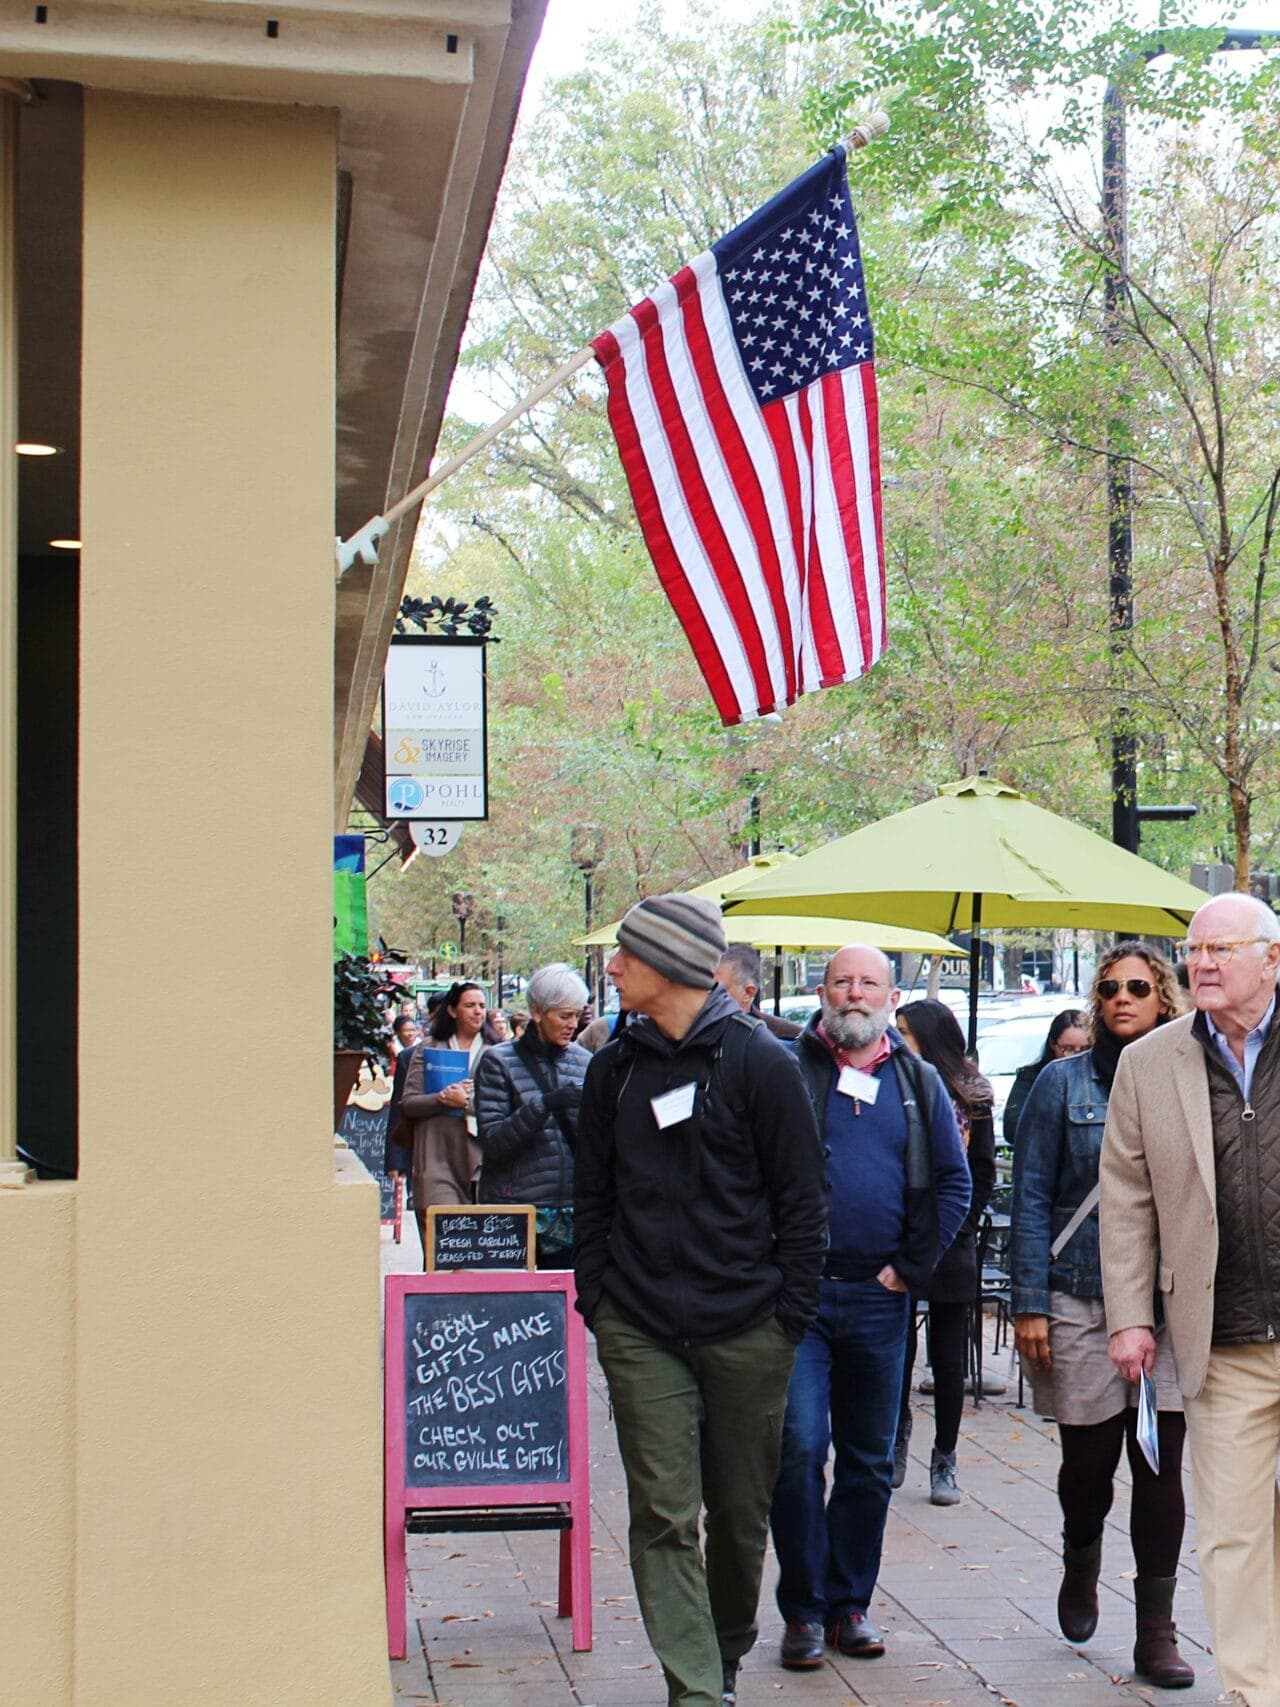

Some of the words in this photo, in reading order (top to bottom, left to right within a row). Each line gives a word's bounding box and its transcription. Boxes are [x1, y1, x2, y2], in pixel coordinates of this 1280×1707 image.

[389, 702, 431, 712] DAVID
[437, 702, 481, 712] AYLOR
[422, 739, 471, 752] SKYRISE
[425, 752, 469, 763] IMAGERY
[425, 784, 482, 798] POHL
[423, 828, 449, 846] 32
[440, 1237, 472, 1249] FRESH
[478, 1234, 520, 1248] CAROLINA
[436, 1251, 484, 1263] GRASS-FED
[487, 1246, 527, 1260] JERKY!
[412, 1314, 489, 1358] LOCAL
[416, 1338, 485, 1384] GIFTS
[493, 1312, 552, 1349] MAKE
[408, 1388, 448, 1416] THE
[446, 1366, 504, 1412] BEST
[511, 1350, 566, 1396] GIFTS
[419, 1424, 486, 1447] CHECK
[496, 1422, 539, 1442] OUT
[414, 1451, 451, 1470] OUR
[454, 1448, 510, 1472] GVILLE
[515, 1439, 563, 1480] GIFTS!
